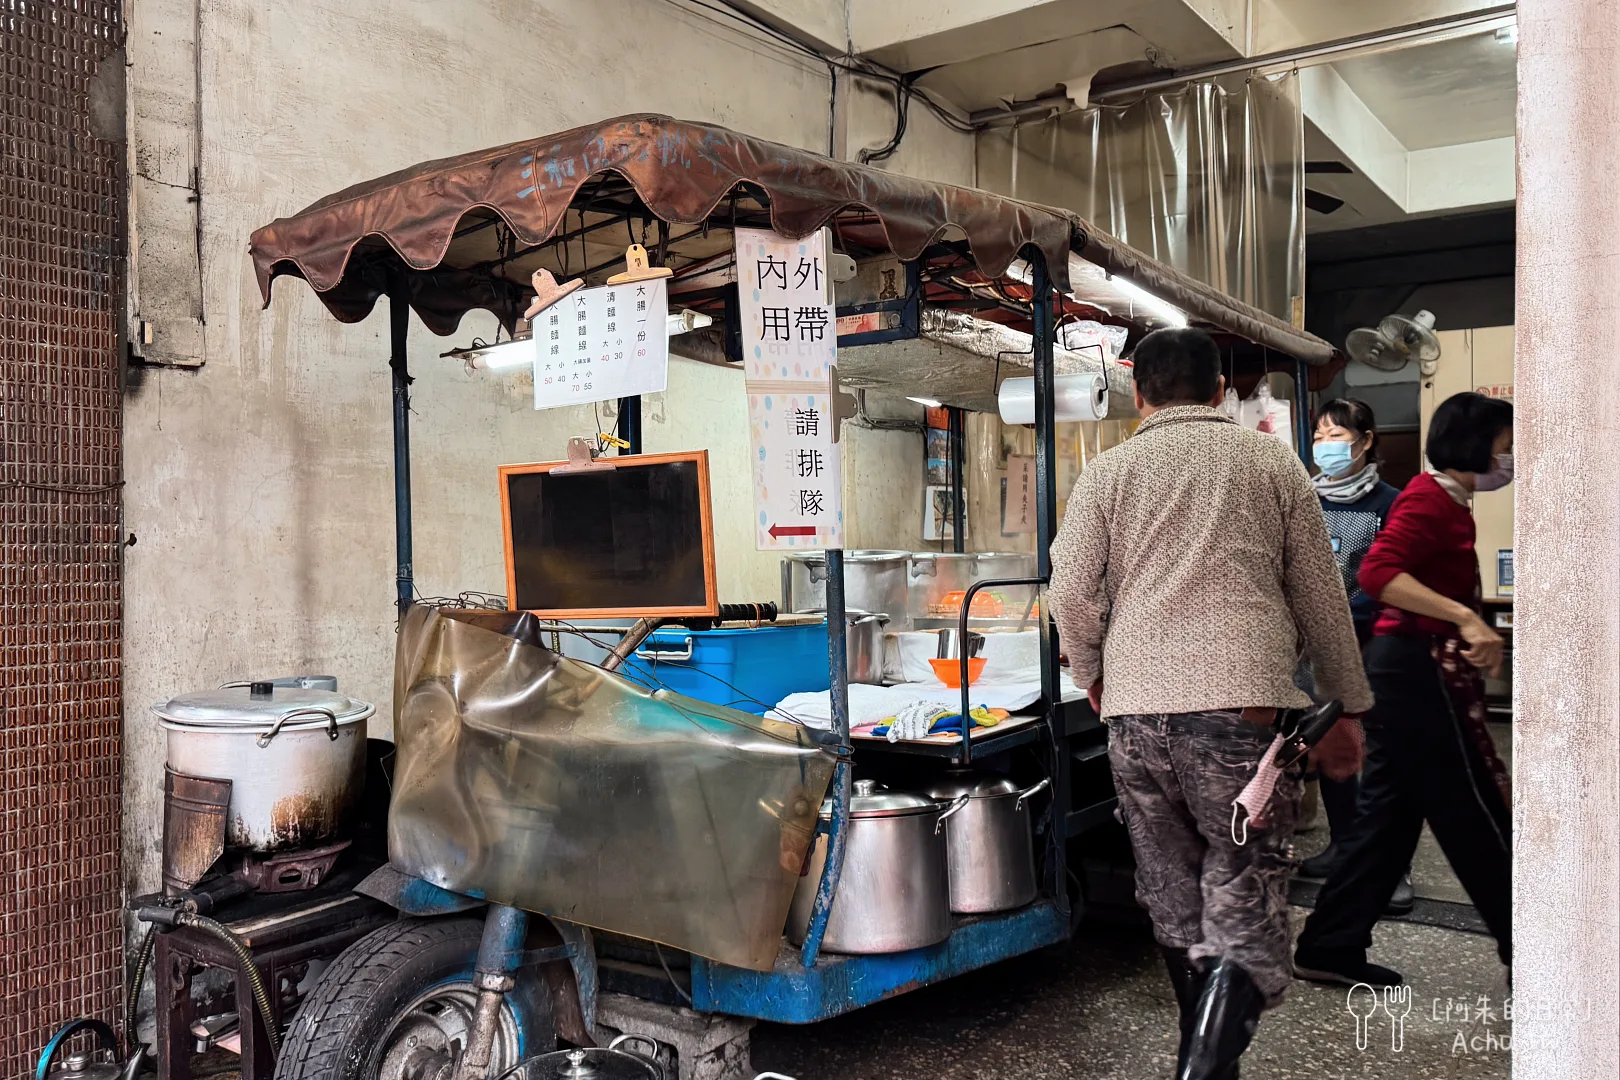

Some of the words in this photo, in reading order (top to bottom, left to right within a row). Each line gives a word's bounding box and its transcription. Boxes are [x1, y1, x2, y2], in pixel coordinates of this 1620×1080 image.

[637, 286, 646, 342] 大腸一份
[615, 352, 623, 360] 30
[638, 349, 646, 357] 60
[545, 377, 553, 385] 50
[558, 375, 566, 383] 40
[795, 408, 825, 516] 請排隊
